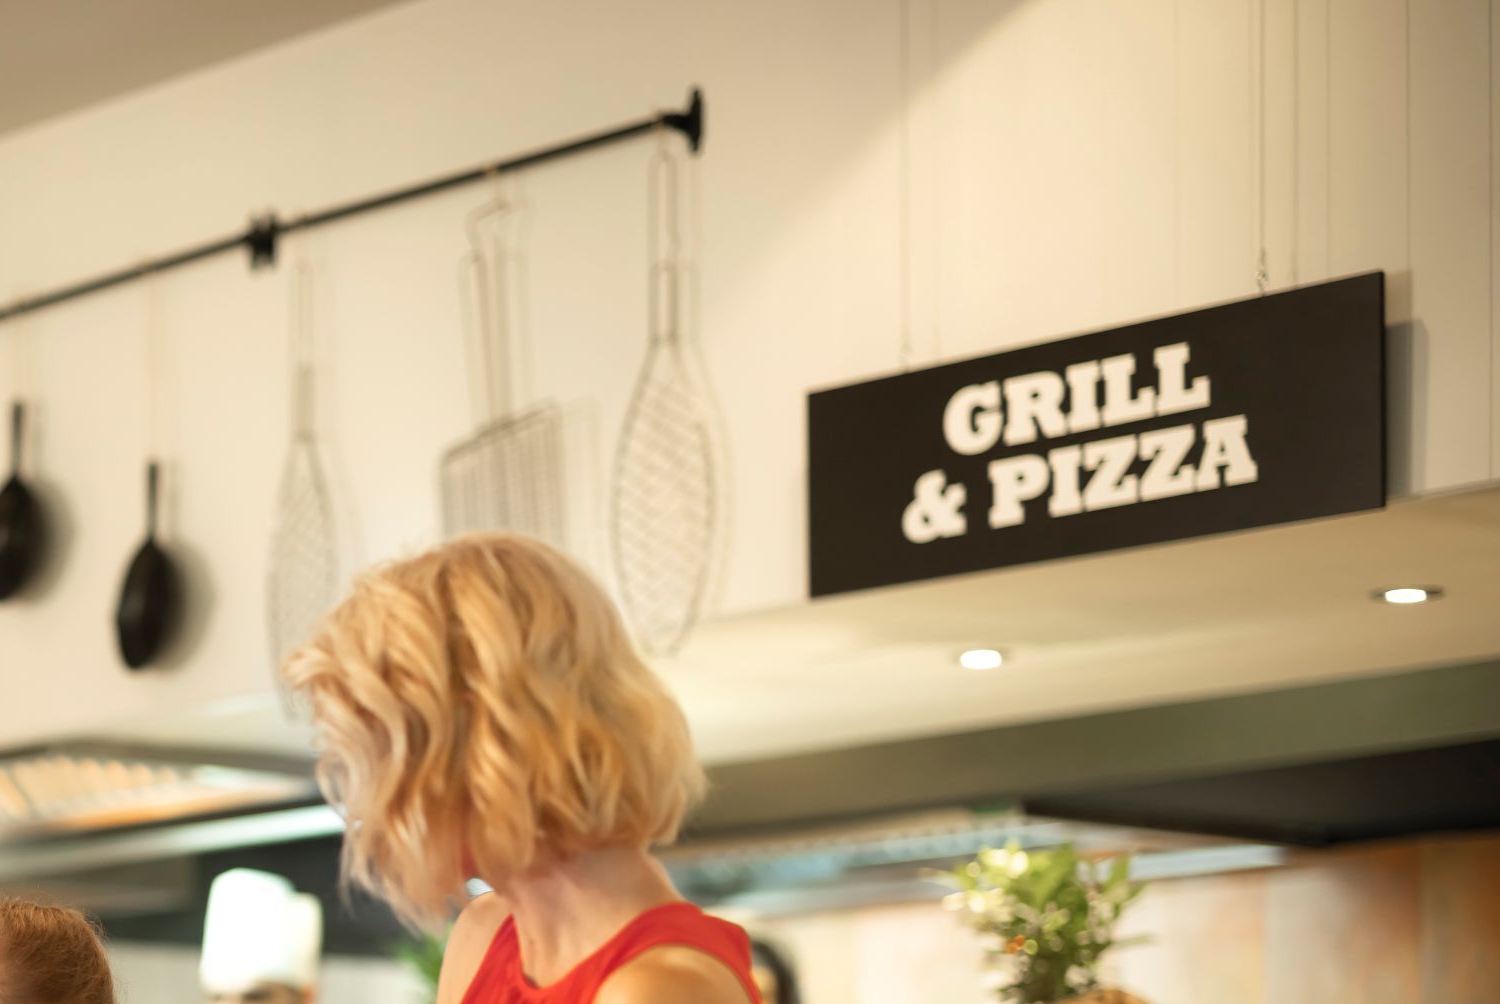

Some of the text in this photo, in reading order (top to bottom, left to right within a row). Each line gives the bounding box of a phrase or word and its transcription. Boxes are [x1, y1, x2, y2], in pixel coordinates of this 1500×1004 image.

[942, 342, 1211, 455] GRILL
[901, 414, 1258, 544] & PIZZA
